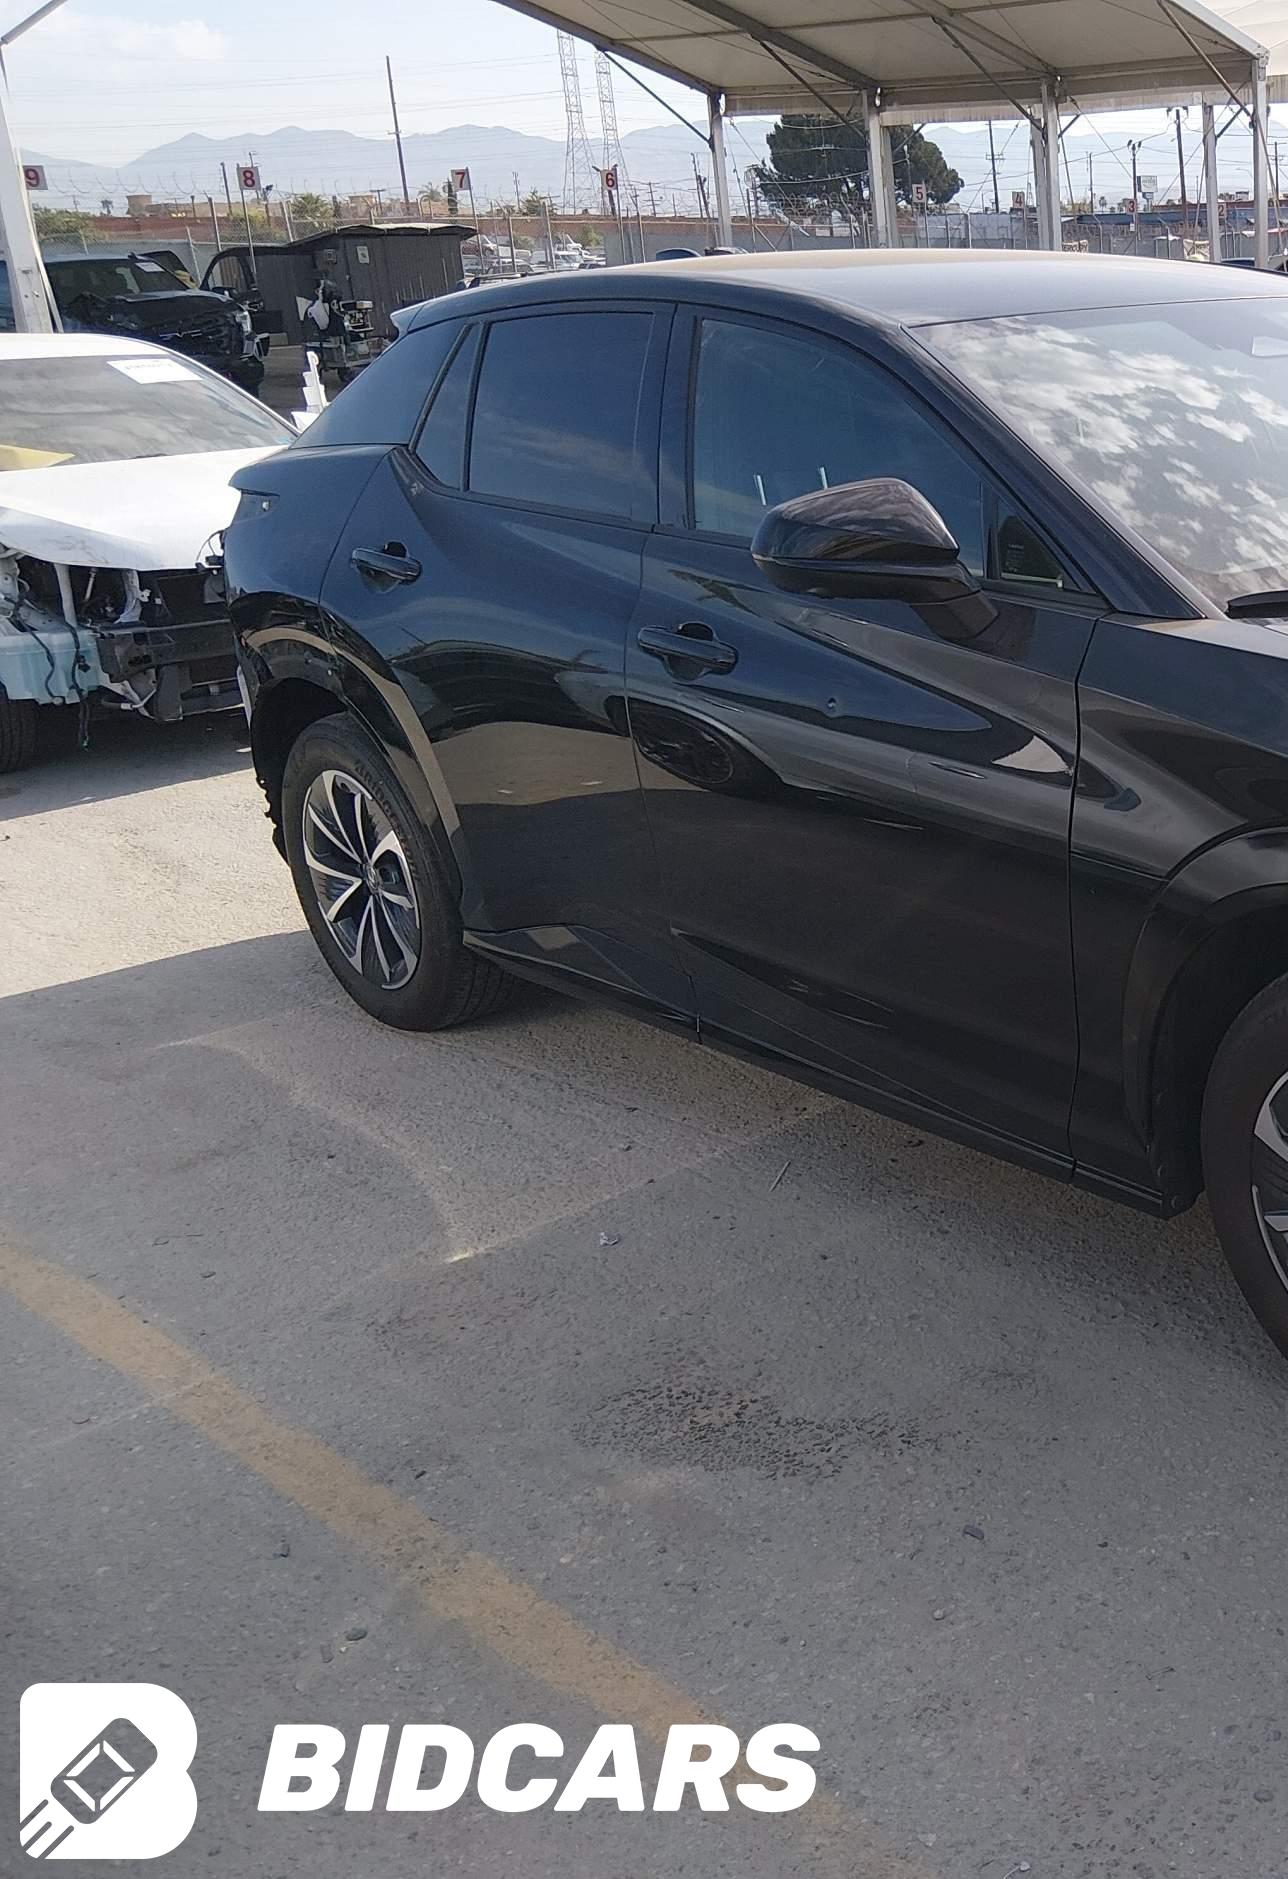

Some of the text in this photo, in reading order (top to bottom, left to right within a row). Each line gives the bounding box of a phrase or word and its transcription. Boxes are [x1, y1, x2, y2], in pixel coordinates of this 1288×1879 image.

[25, 168, 40, 187] 9
[242, 170, 256, 188] 8
[455, 172, 466, 188] 7
[605, 173, 615, 188] 6
[915, 186, 924, 200] 5
[1014, 194, 1022, 206] 4
[1128, 200, 1135, 213] 3
[1218, 205, 1225, 217] 2
